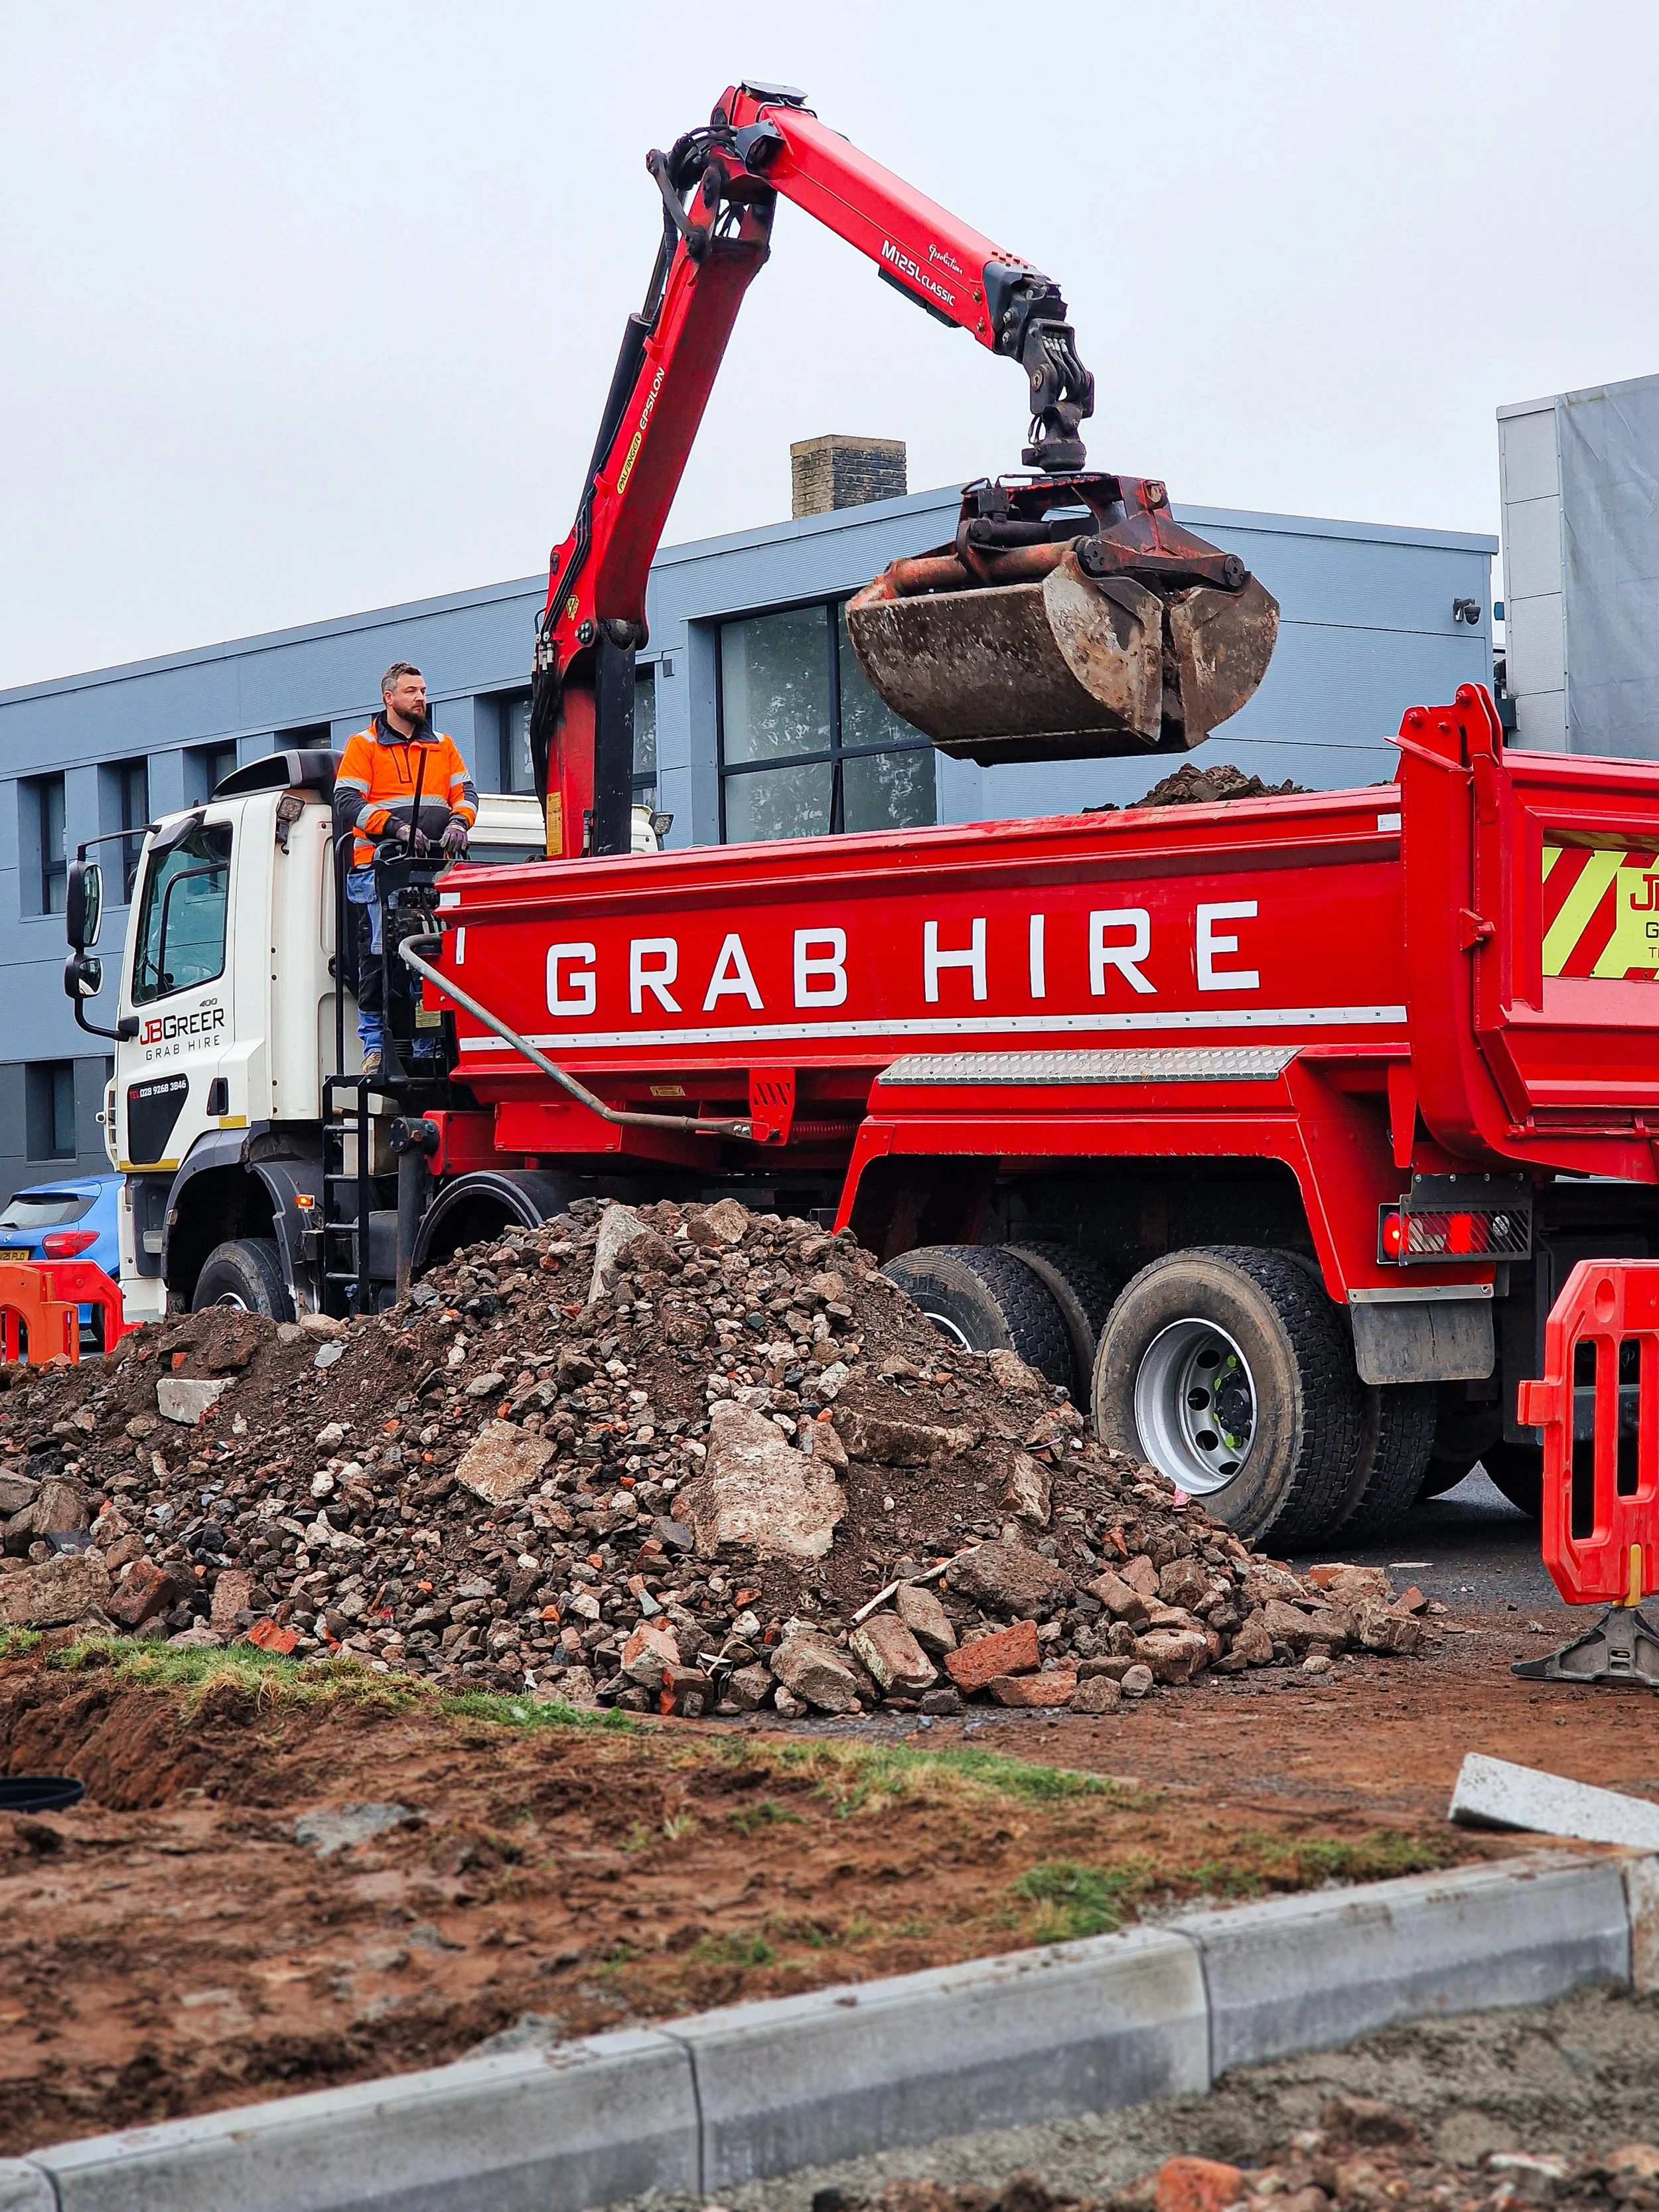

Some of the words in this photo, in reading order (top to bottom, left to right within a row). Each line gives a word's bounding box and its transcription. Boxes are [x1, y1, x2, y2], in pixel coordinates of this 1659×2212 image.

[921, 274, 956, 307] CLASSIC
[618, 435, 641, 491] PALFINGER
[640, 366, 665, 430] EPSILON
[546, 927, 847, 1016] GRAB
[924, 900, 1260, 1002] HIRE
[199, 997, 218, 1007] 400
[146, 1043, 180, 1061] GRAB
[188, 1035, 220, 1051] HIRE
[140, 1087, 152, 1098] 028
[153, 1083, 169, 1095] 9268
